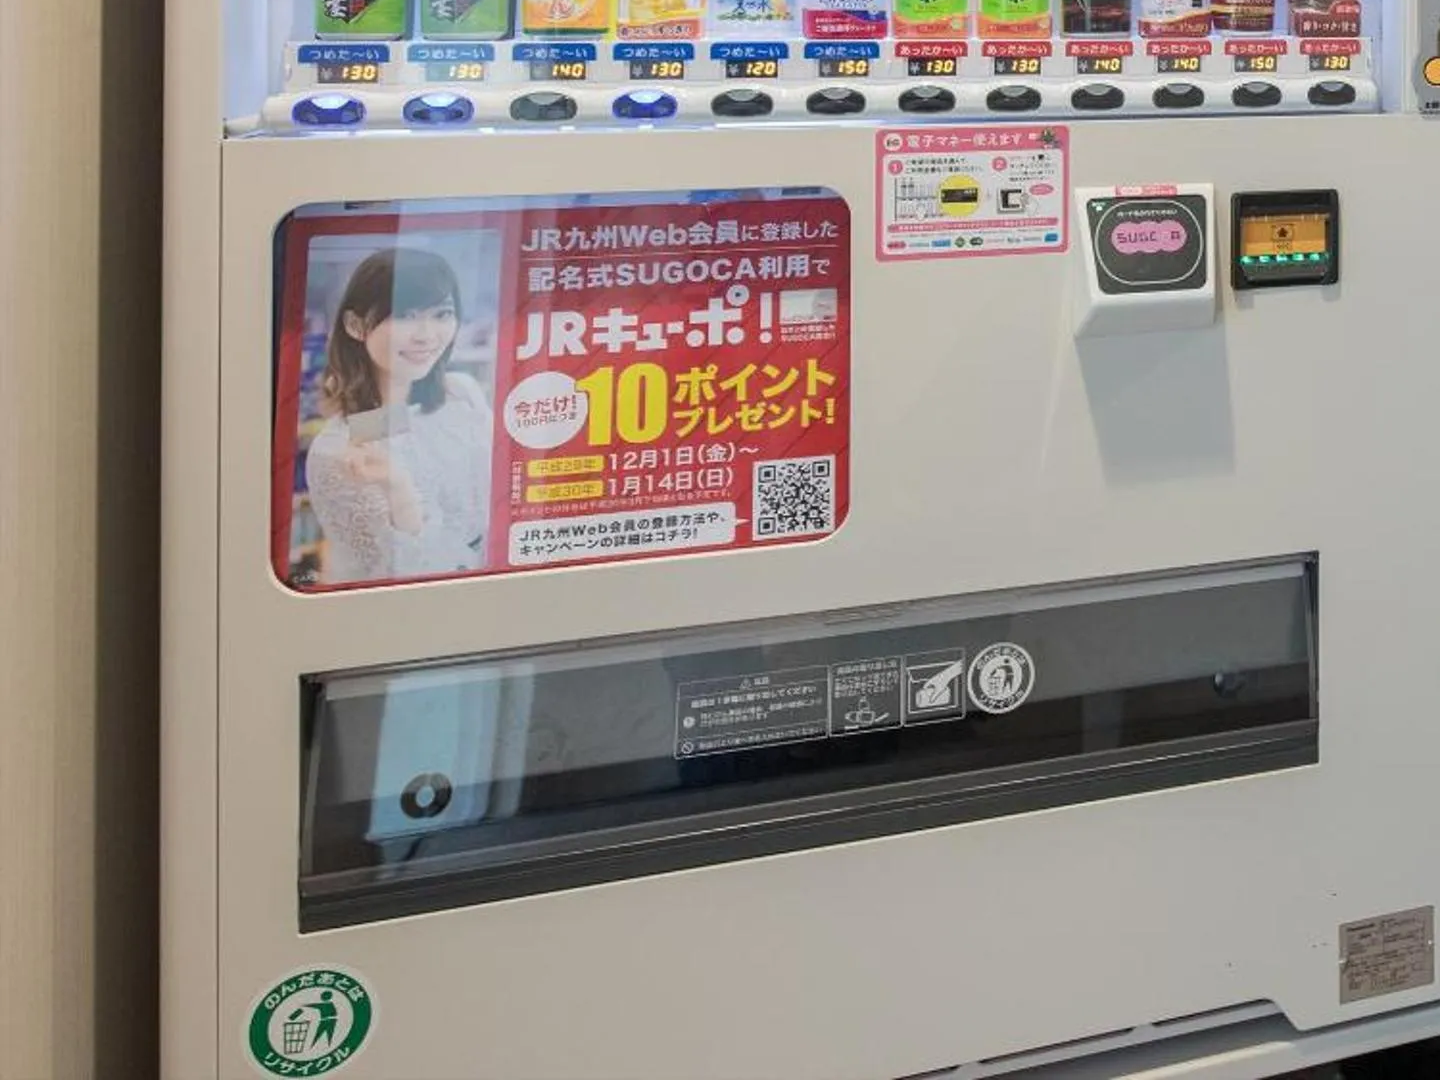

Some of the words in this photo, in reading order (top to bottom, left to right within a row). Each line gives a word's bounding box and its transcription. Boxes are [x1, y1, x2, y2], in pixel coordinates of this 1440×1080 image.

[342, 64, 376, 79] 130
[651, 61, 682, 76] 130
[746, 61, 775, 75] 120
[838, 60, 866, 74] 150
[926, 60, 954, 72] 130
[1011, 59, 1039, 72] 130
[1094, 58, 1119, 71] 140
[1173, 58, 1198, 70] 140
[1250, 58, 1274, 70] 150
[521, 220, 839, 253] JR九州Web会員に登録した
[528, 253, 831, 293] 記名式SUGOCA利用で
[515, 284, 774, 361] JRキューポ!
[673, 358, 836, 406] ポイント
[513, 393, 578, 416] 今だけ!
[575, 362, 669, 446] 10
[672, 398, 835, 438] プレゼント!
[608, 470, 733, 497] 1月14日(日)
[519, 512, 729, 543] JR九州Web会員の登録方法や、
[519, 526, 699, 558] キャンペーンの詳細はコチラ!
[264, 972, 365, 1010] のんだあとは
[264, 1046, 351, 1075] リサイクル
